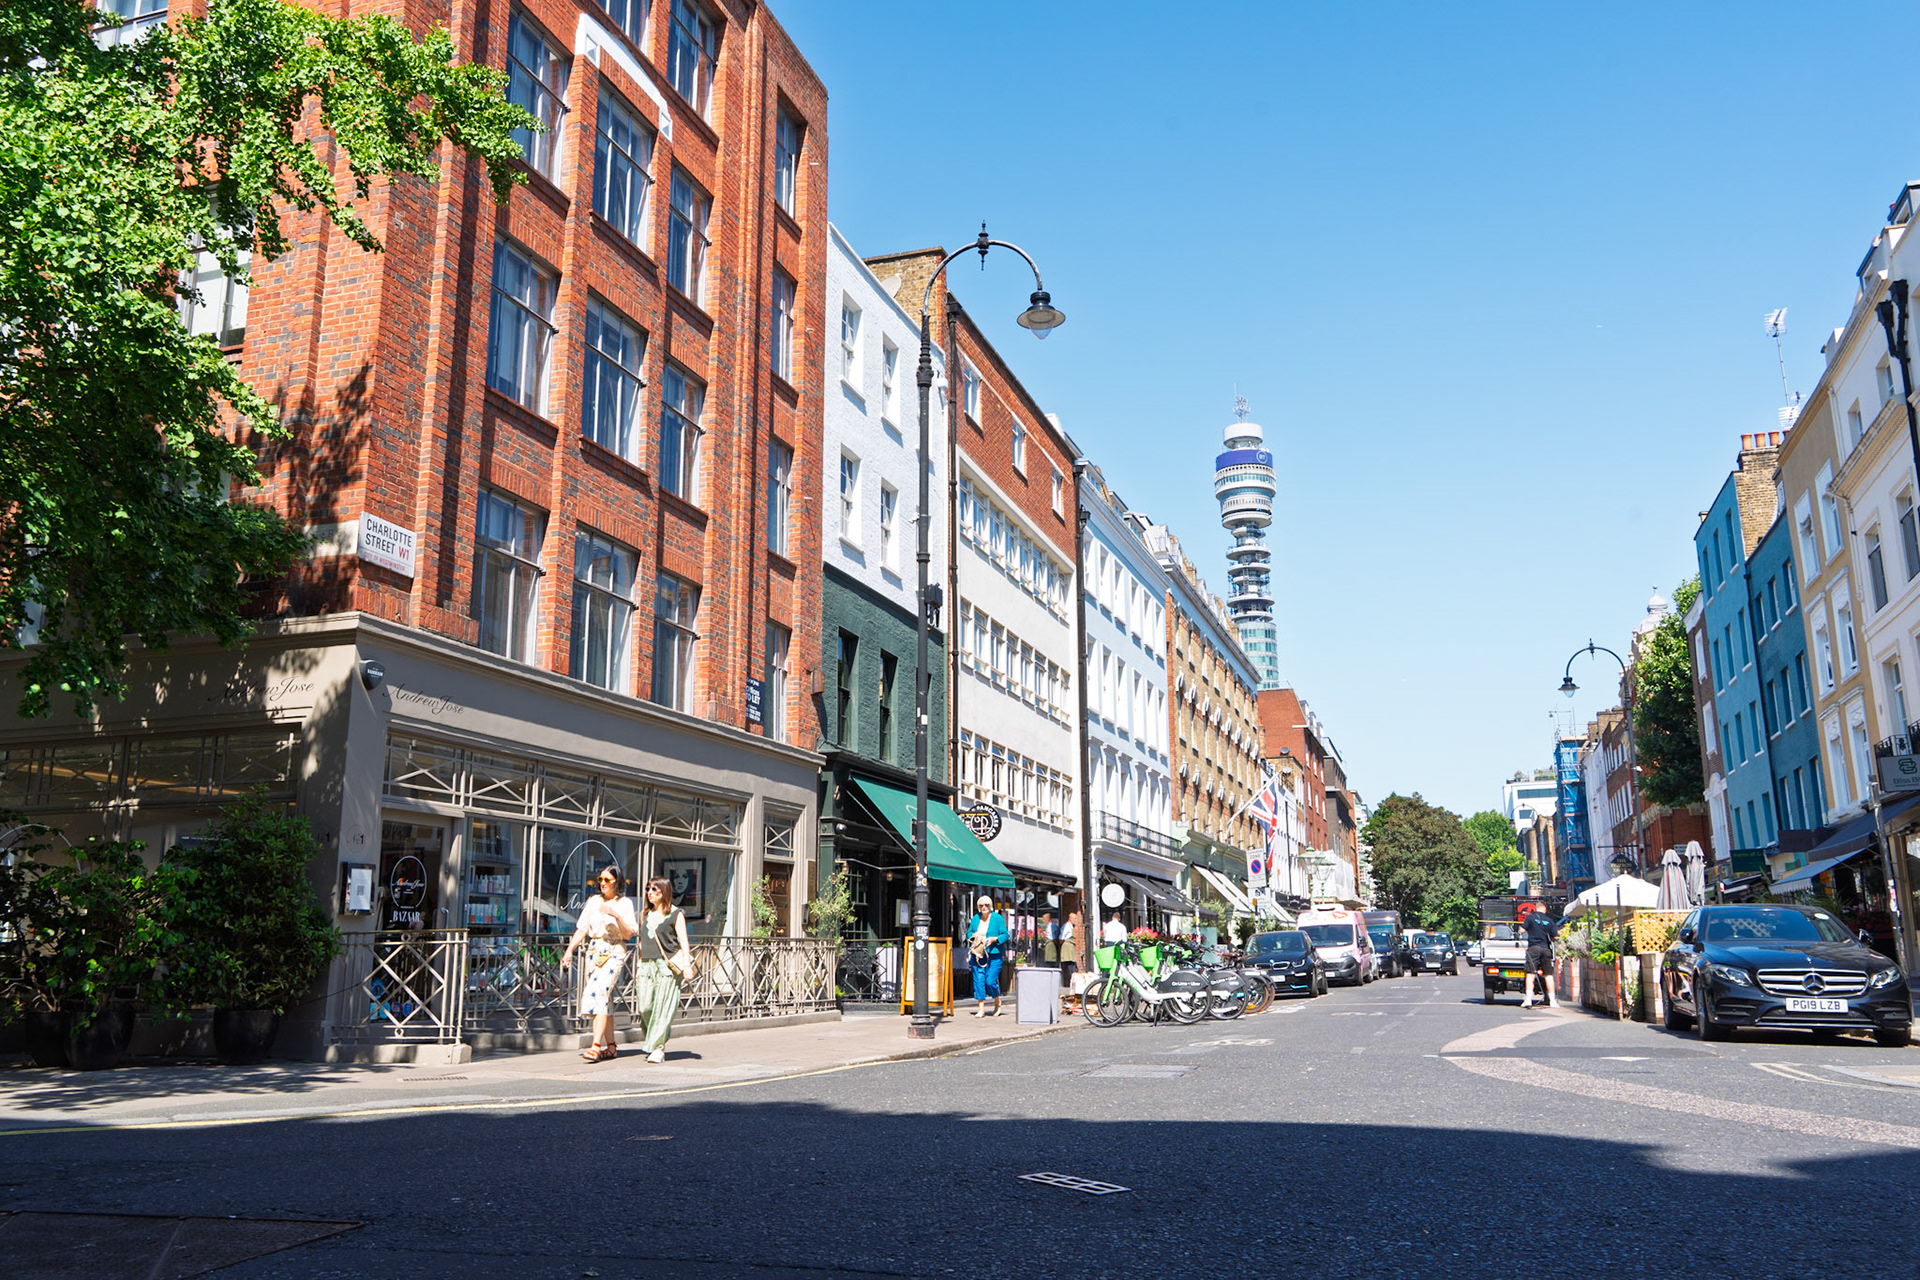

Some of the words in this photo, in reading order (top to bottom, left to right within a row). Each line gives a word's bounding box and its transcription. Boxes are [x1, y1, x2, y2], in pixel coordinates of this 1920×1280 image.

[367, 519, 412, 547] CHARLOTTE
[366, 533, 395, 554] STREET
[399, 546, 409, 560] W1
[269, 676, 316, 702] Jose
[382, 683, 440, 709] Andrew
[431, 695, 466, 716] Jose
[751, 694, 761, 705] LET
[392, 910, 421, 923] BAZAAR
[1792, 999, 1817, 1010] PG19
[1819, 1001, 1841, 1011] LZB
